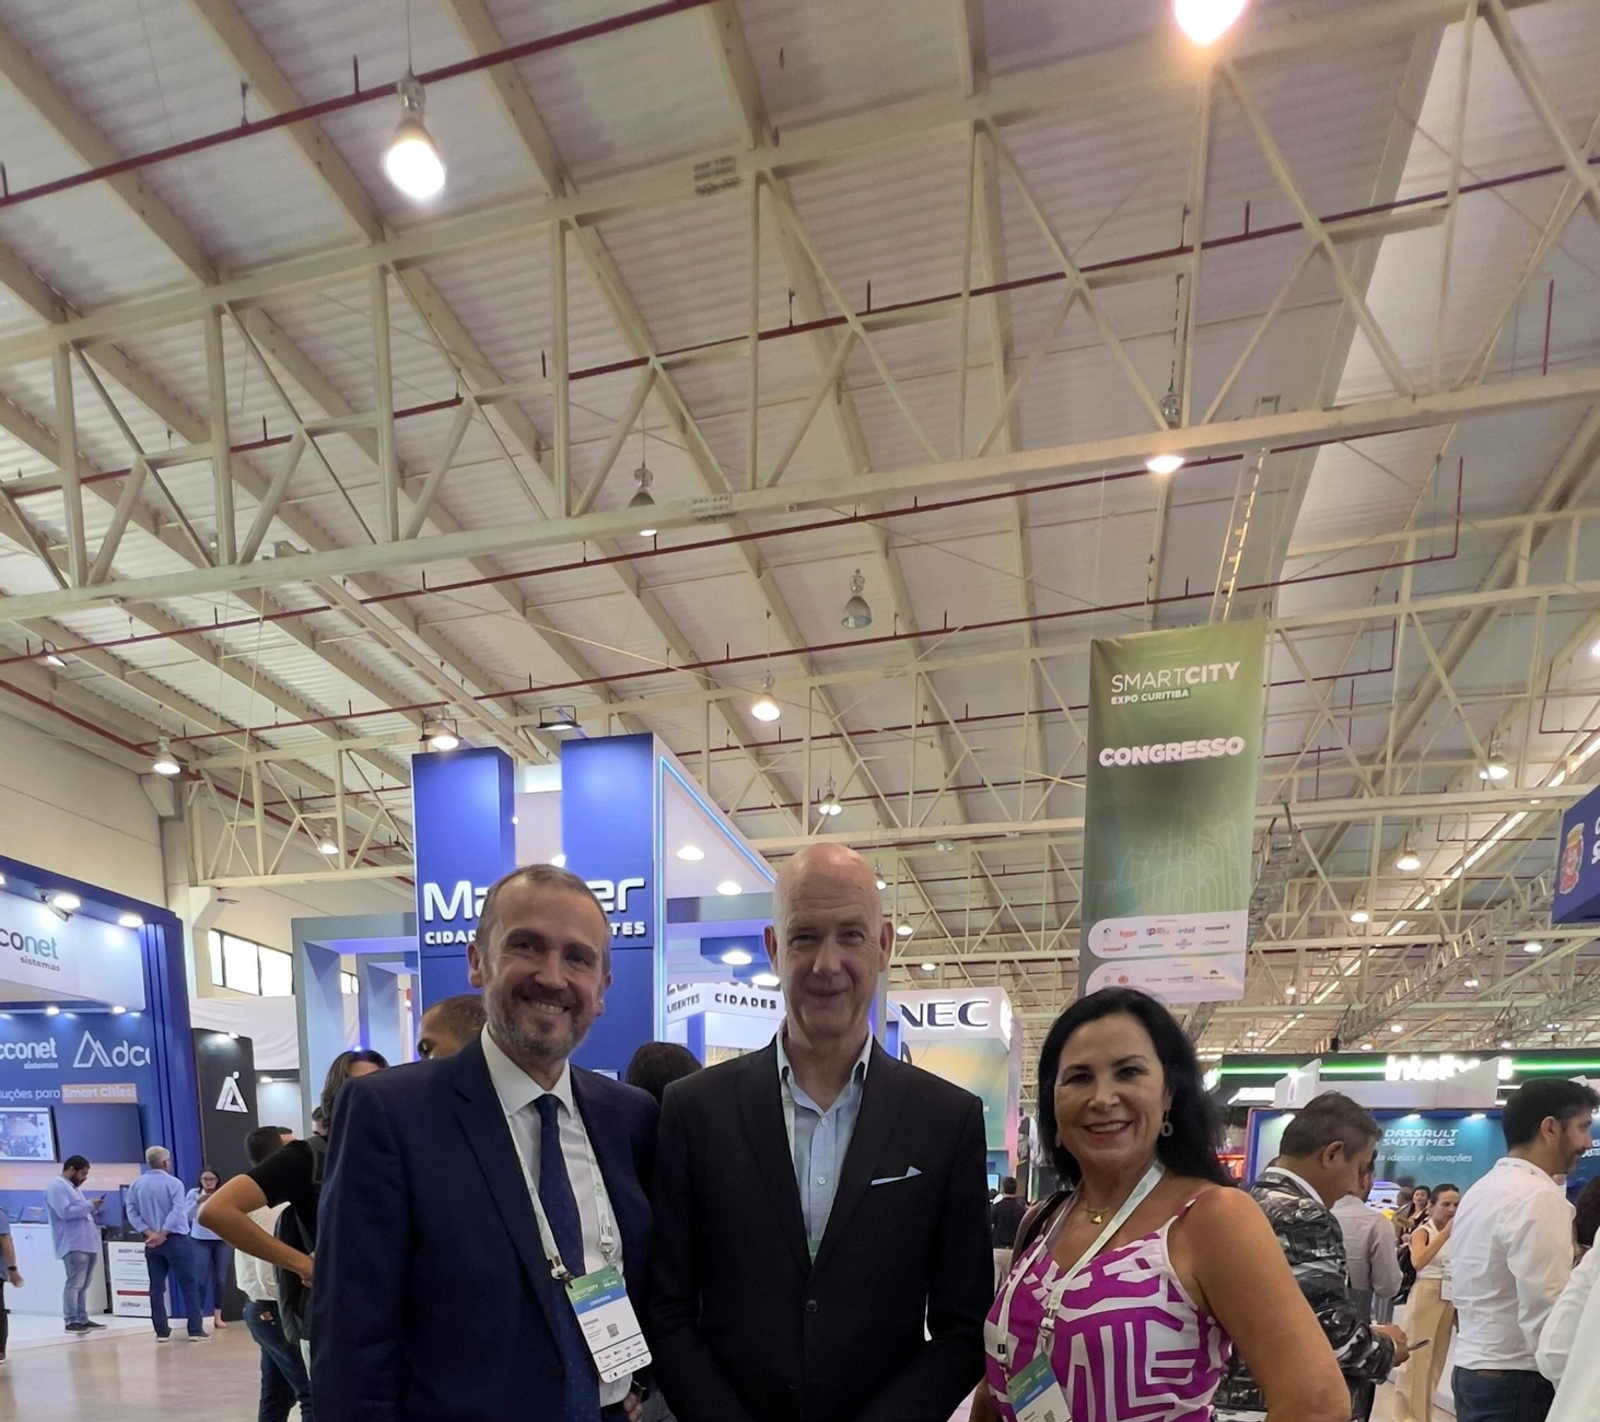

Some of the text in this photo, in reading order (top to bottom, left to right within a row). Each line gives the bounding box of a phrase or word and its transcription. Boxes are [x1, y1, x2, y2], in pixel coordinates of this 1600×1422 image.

[1111, 661, 1240, 693] SMARTCITY
[1111, 689, 1189, 705] EXPO CURITIBA
[1099, 736, 1245, 766] CONGRESSO
[20, 955, 61, 972] sistemas
[714, 993, 777, 1010] CIDADES
[900, 1000, 989, 1028] NEC
[35, 1089, 60, 1101] para
[63, 1086, 98, 1098] Smart
[1385, 1129, 1459, 1138] DASSAULT
[1387, 1152, 1415, 1162] ideias
[1418, 1154, 1423, 1162] e
[1426, 1153, 1473, 1164] inovações
